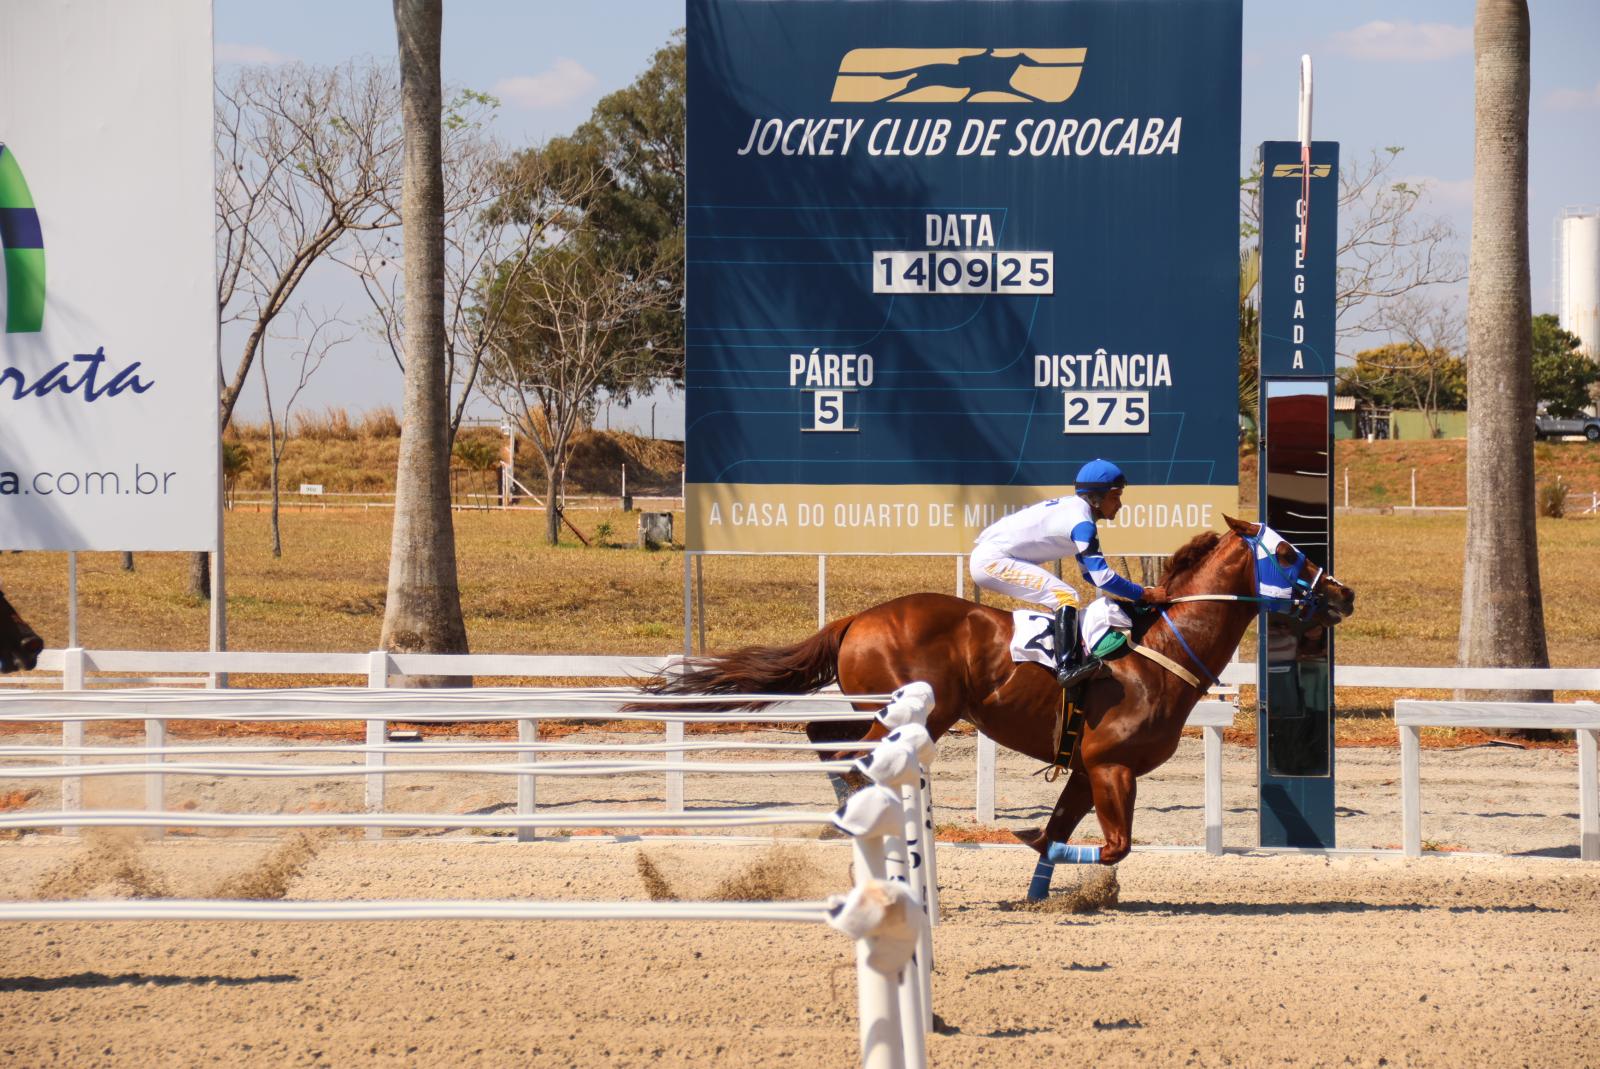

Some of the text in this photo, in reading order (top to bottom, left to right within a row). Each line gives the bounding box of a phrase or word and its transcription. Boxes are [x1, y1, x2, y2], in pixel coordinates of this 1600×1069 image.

[737, 116, 1183, 157] JOCKEY CLUB DE SOROCABA
[925, 213, 995, 247] DATA
[789, 347, 875, 387] PÁREO
[1034, 347, 1172, 387] DISTÂNCIA
[818, 395, 840, 425] 5
[1067, 396, 1146, 426] 275
[708, 502, 723, 526] A
[731, 502, 788, 527] CASA
[798, 503, 825, 527] DO
[834, 503, 920, 528] QUARTO
[928, 503, 955, 527] DE
